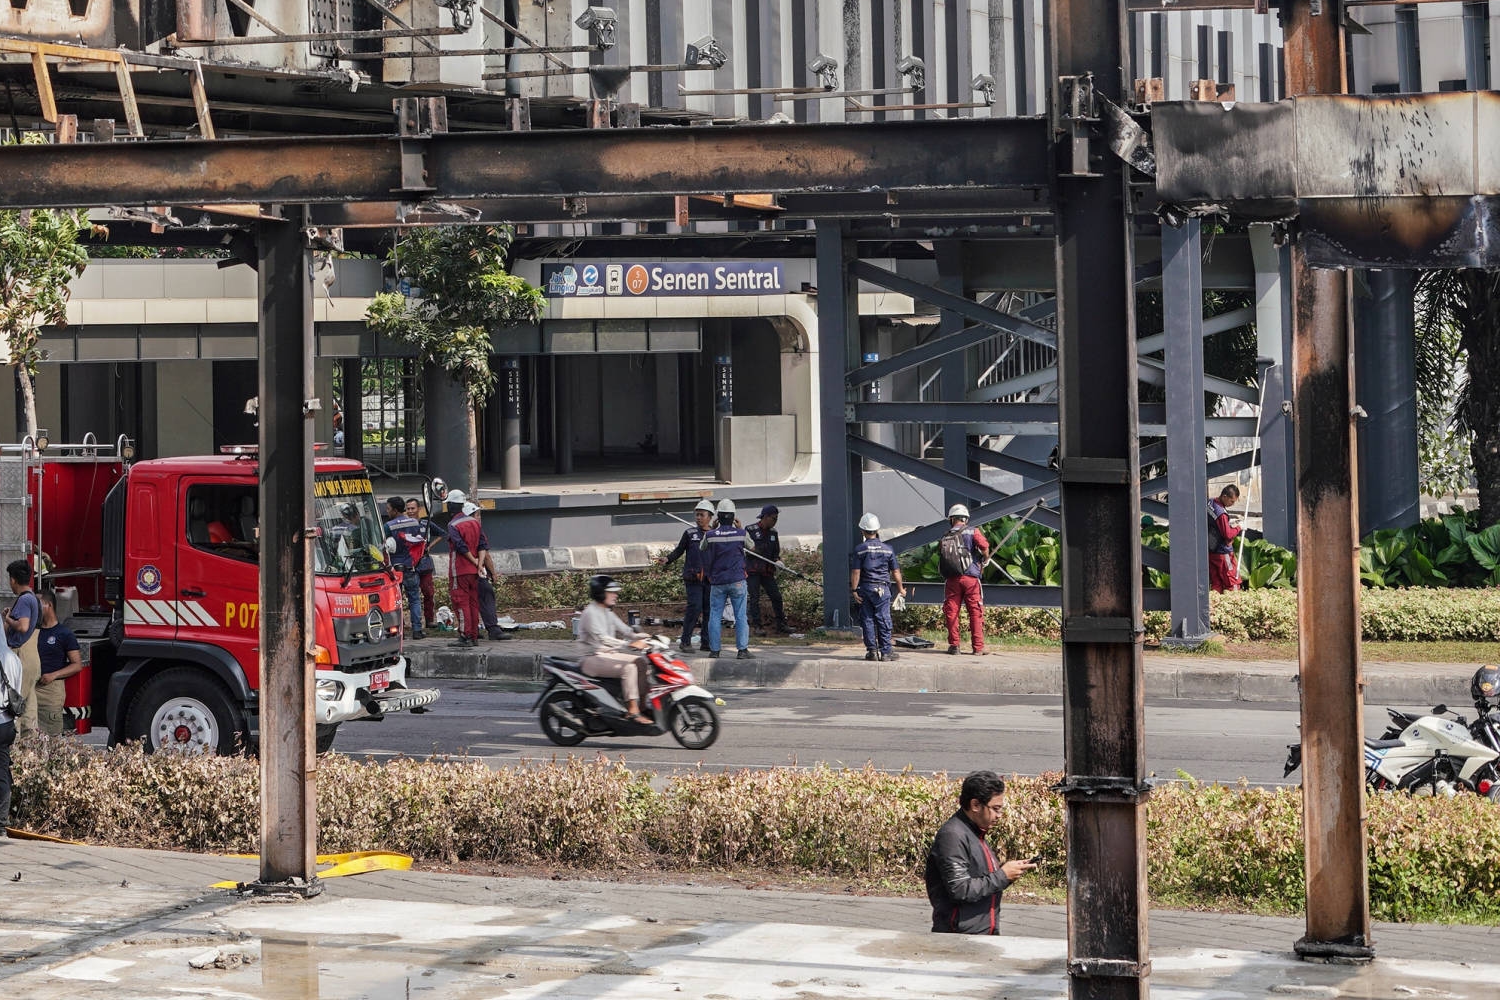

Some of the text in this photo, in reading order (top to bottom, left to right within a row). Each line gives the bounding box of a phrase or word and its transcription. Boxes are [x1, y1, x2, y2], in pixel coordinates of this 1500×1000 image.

[632, 280, 643, 289] 07
[651, 266, 781, 291] Senen Sentral
[226, 602, 236, 627] P
